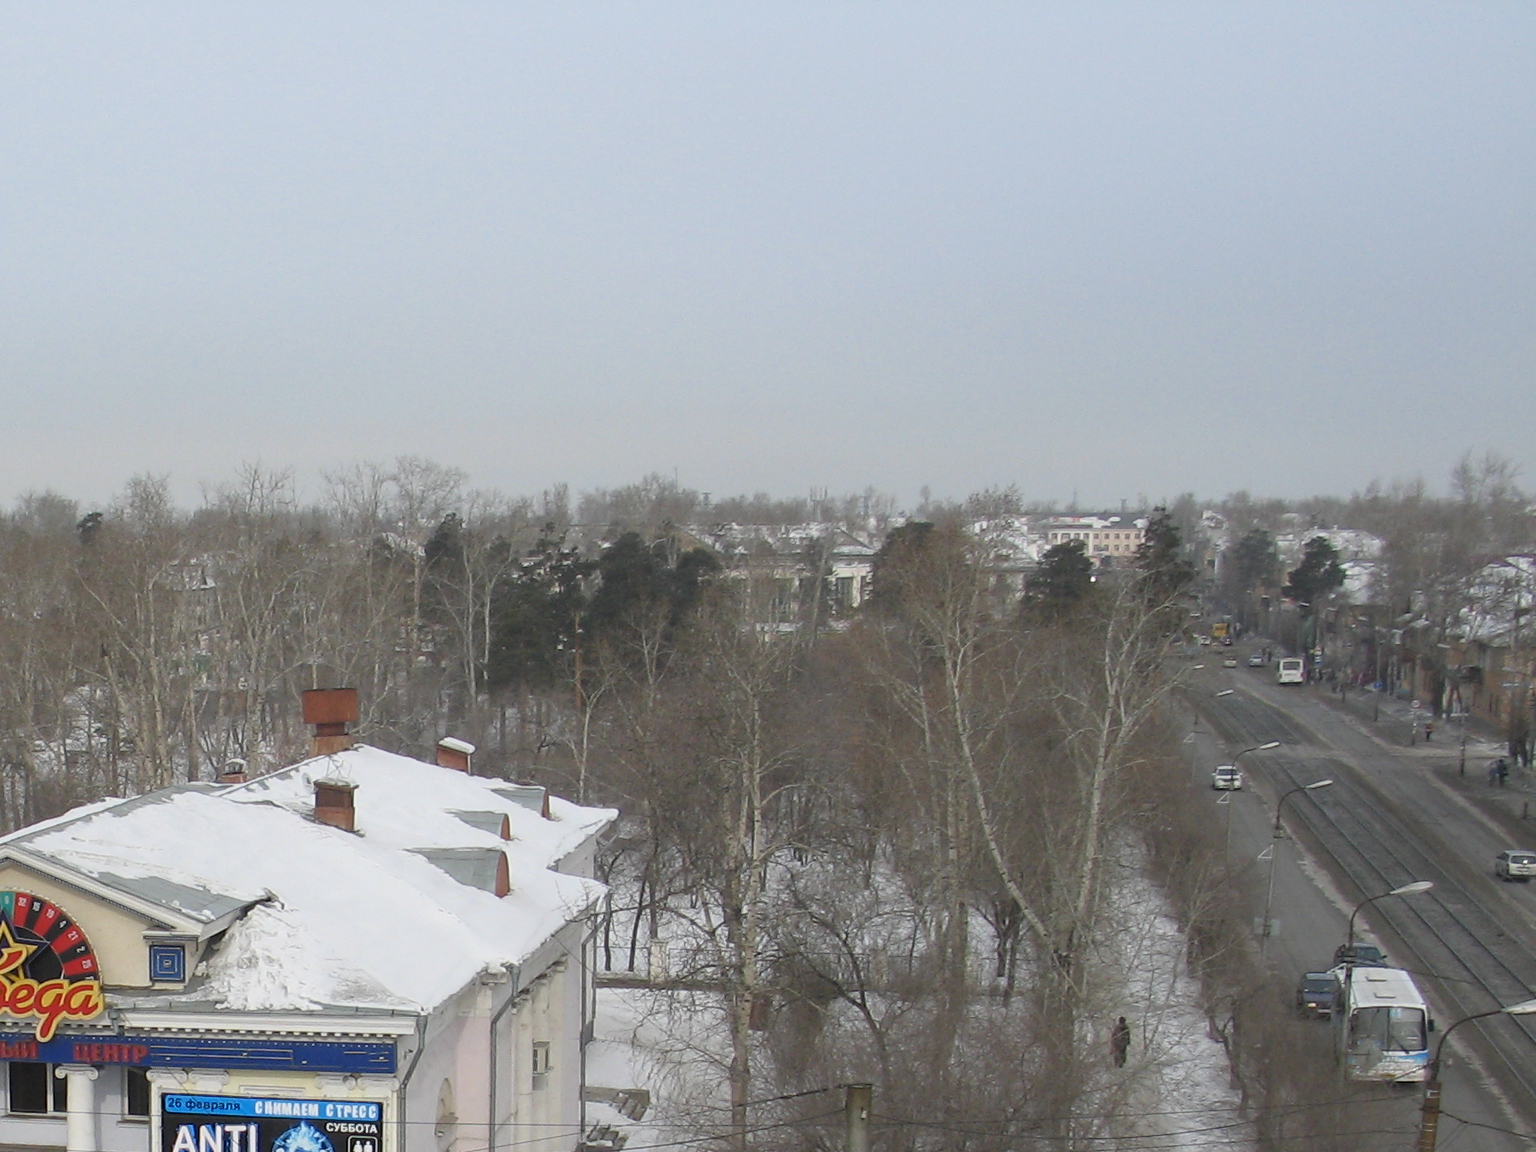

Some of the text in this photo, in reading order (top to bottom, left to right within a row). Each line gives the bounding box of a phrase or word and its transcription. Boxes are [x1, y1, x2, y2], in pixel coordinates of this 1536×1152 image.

[68, 930, 79, 940] 21
[76, 946, 86, 954] 2
[73, 1043, 149, 1064] ЦЕНТР
[168, 1097, 241, 1112] 26 февраля
[325, 1122, 378, 1134] СУББОТА
